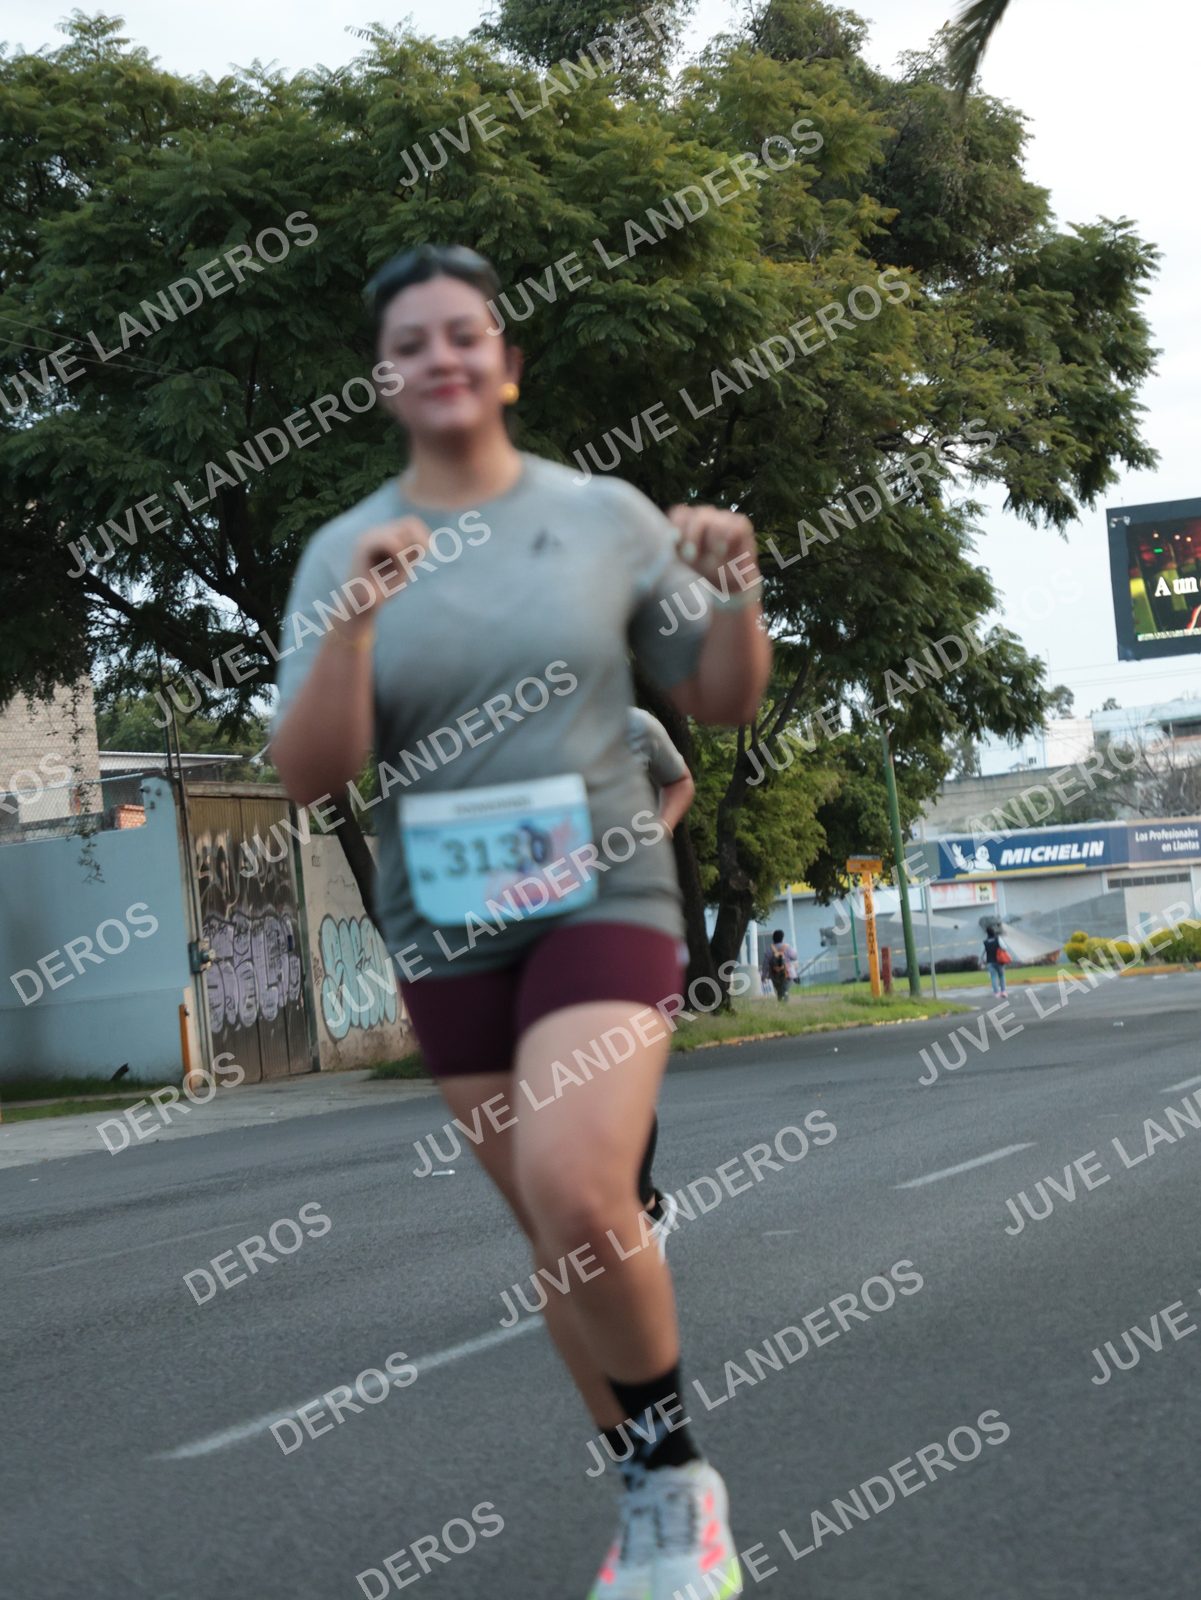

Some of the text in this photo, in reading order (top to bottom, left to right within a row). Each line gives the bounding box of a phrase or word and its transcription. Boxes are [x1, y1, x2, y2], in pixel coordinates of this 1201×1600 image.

[1154, 576, 1171, 597] A
[1135, 827, 1199, 843] Los Profesionales
[1000, 840, 1105, 866] MICHELIN
[1161, 840, 1200, 852] en Llantas
